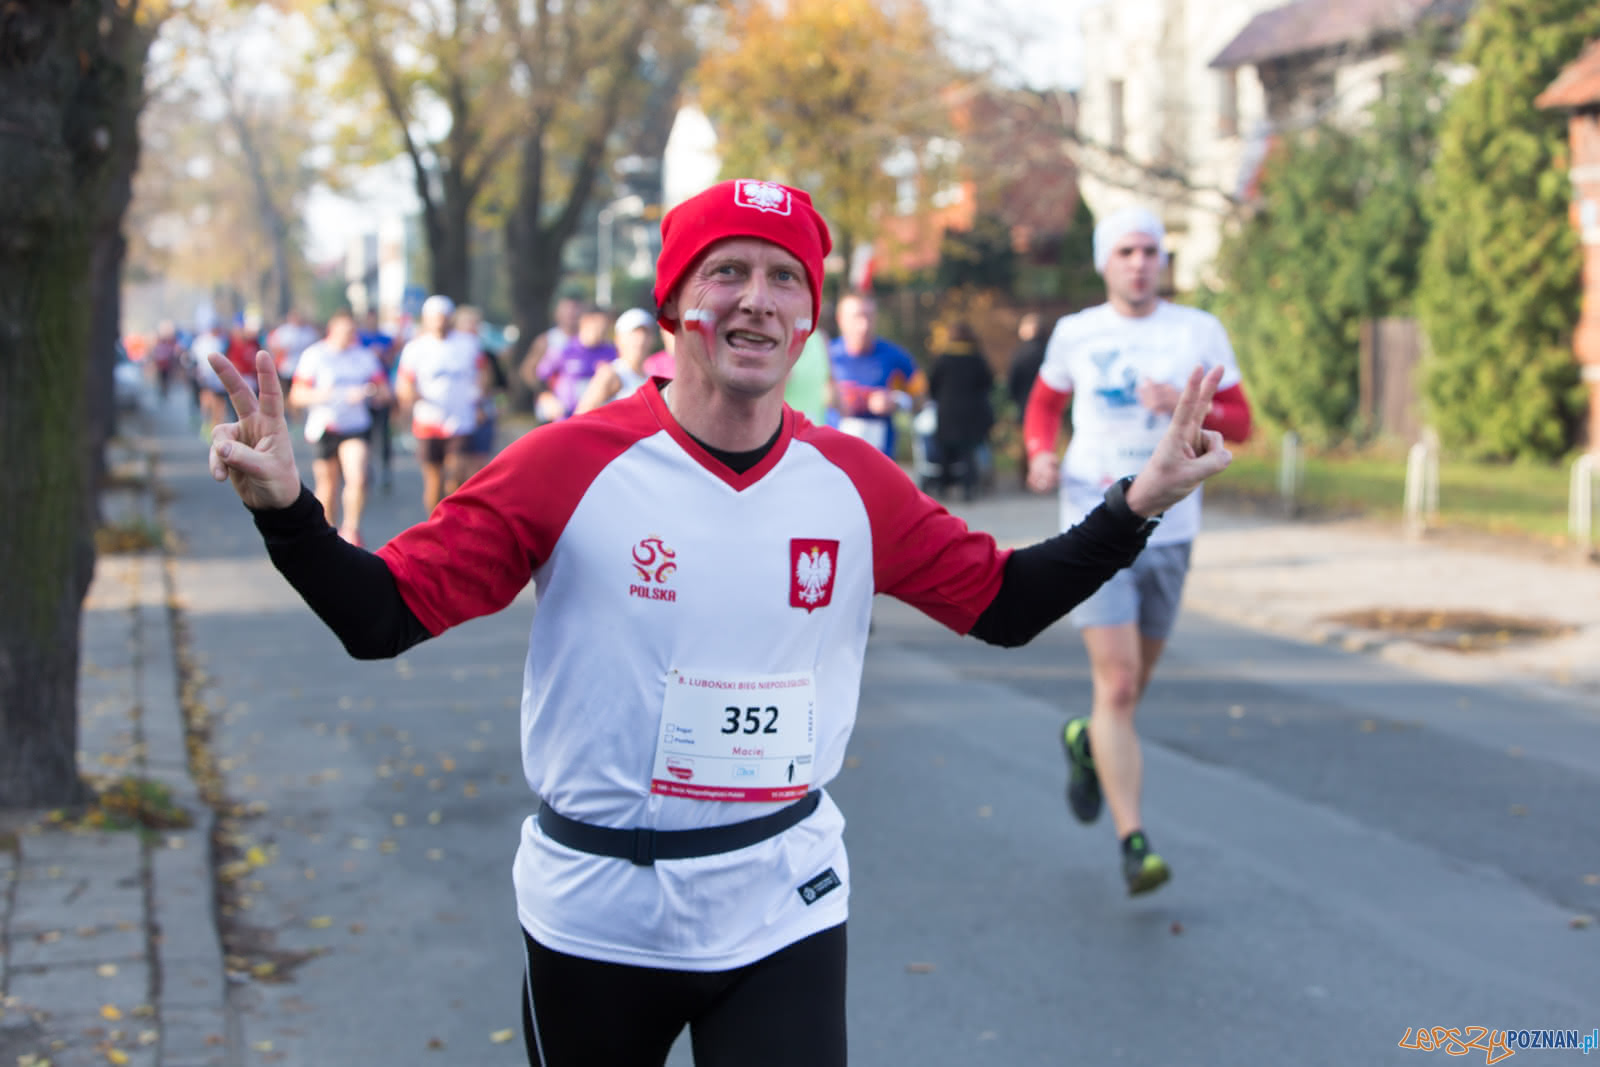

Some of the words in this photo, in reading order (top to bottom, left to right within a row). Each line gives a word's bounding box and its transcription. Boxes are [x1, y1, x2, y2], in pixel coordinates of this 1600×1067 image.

[629, 584, 676, 602] POLSKA
[738, 681, 756, 690] BIEG
[720, 706, 779, 735] 352
[732, 746, 764, 760] Maciej
